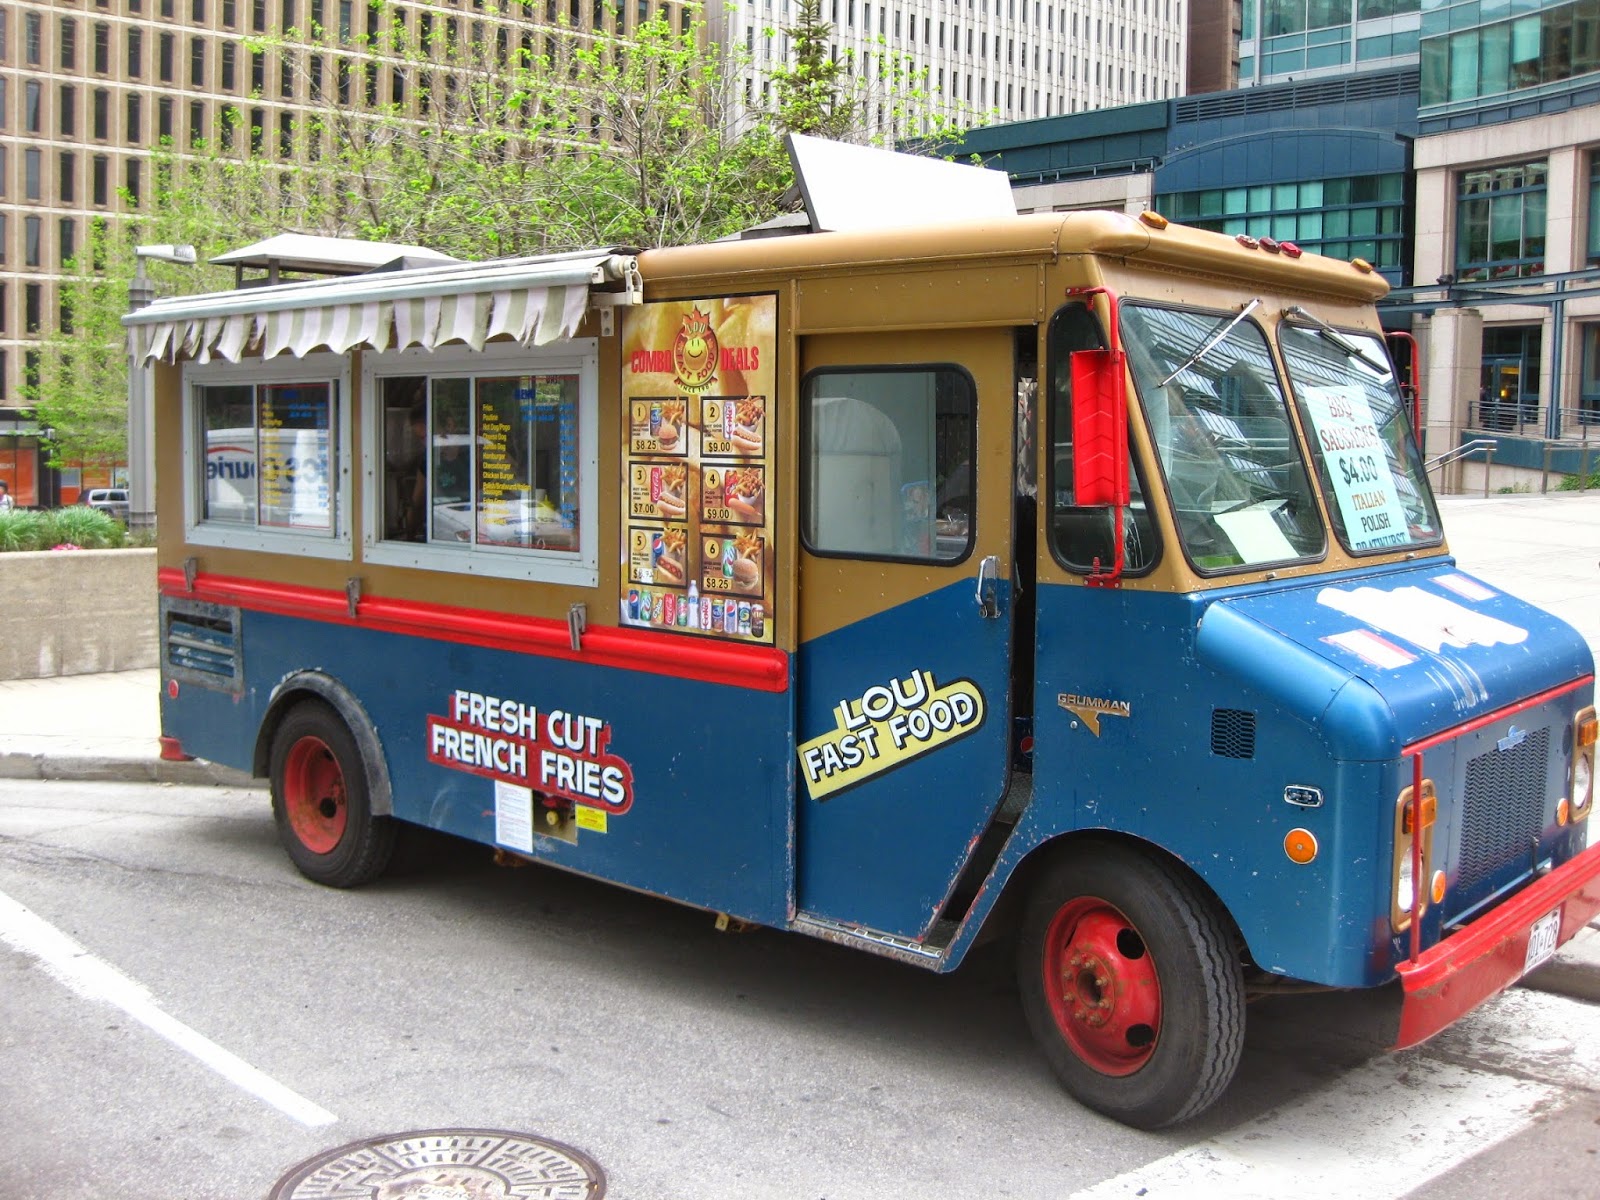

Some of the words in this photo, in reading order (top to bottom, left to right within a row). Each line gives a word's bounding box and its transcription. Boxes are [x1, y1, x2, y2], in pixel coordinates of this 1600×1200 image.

[631, 350, 673, 373] COMBO
[720, 346, 759, 371] DEALS
[697, 352, 715, 381] FOOD
[482, 403, 493, 412] Fries
[1326, 394, 1355, 421] BBQ
[636, 440, 657, 451] $8.25
[708, 442, 731, 453] $9.00
[1320, 425, 1379, 452] SAUSAGES
[1339, 455, 1378, 487] $4.00
[634, 503, 655, 514] $7.00
[1351, 490, 1386, 511] ITALIAN
[707, 508, 730, 520] $9.00
[1361, 512, 1391, 533] POLISH
[706, 577, 729, 589] $8.25
[839, 669, 929, 731] LOU
[1057, 693, 1130, 711] GRUMMAN
[455, 689, 537, 741] FRESH
[547, 709, 603, 756] CUT
[803, 727, 878, 783] FAST
[888, 692, 977, 749] FOOD
[432, 723, 528, 778] FRENCH
[541, 750, 626, 804] FRIES
